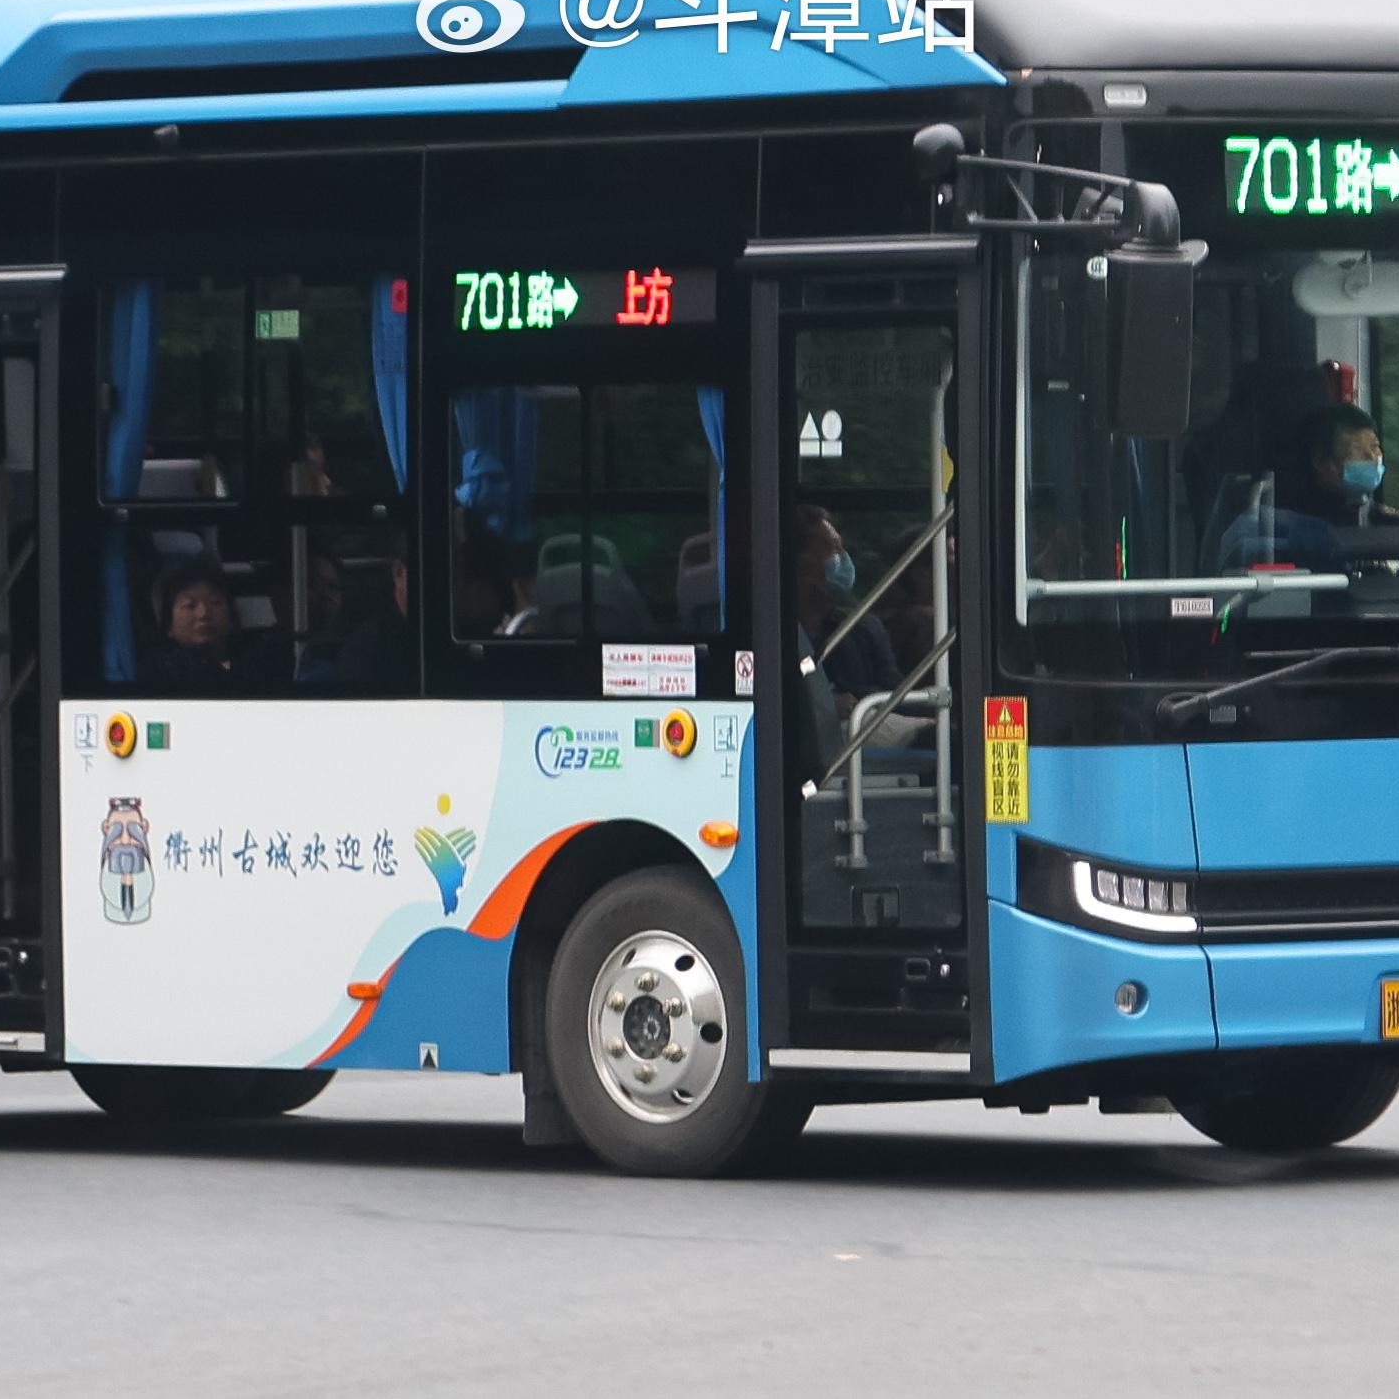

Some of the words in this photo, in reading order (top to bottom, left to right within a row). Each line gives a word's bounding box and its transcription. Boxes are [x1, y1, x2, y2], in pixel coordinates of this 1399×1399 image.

[1224, 137, 1373, 214] 701路
[455, 270, 555, 331] 701路
[616, 266, 674, 326] 上方
[81, 754, 94, 773] 下
[554, 747, 621, 769] 12328
[720, 756, 734, 778] 上
[992, 742, 1005, 816] 视线盲区
[1007, 742, 1020, 816] 请勿靠近
[164, 826, 398, 877] 衢州古城欢迎您
